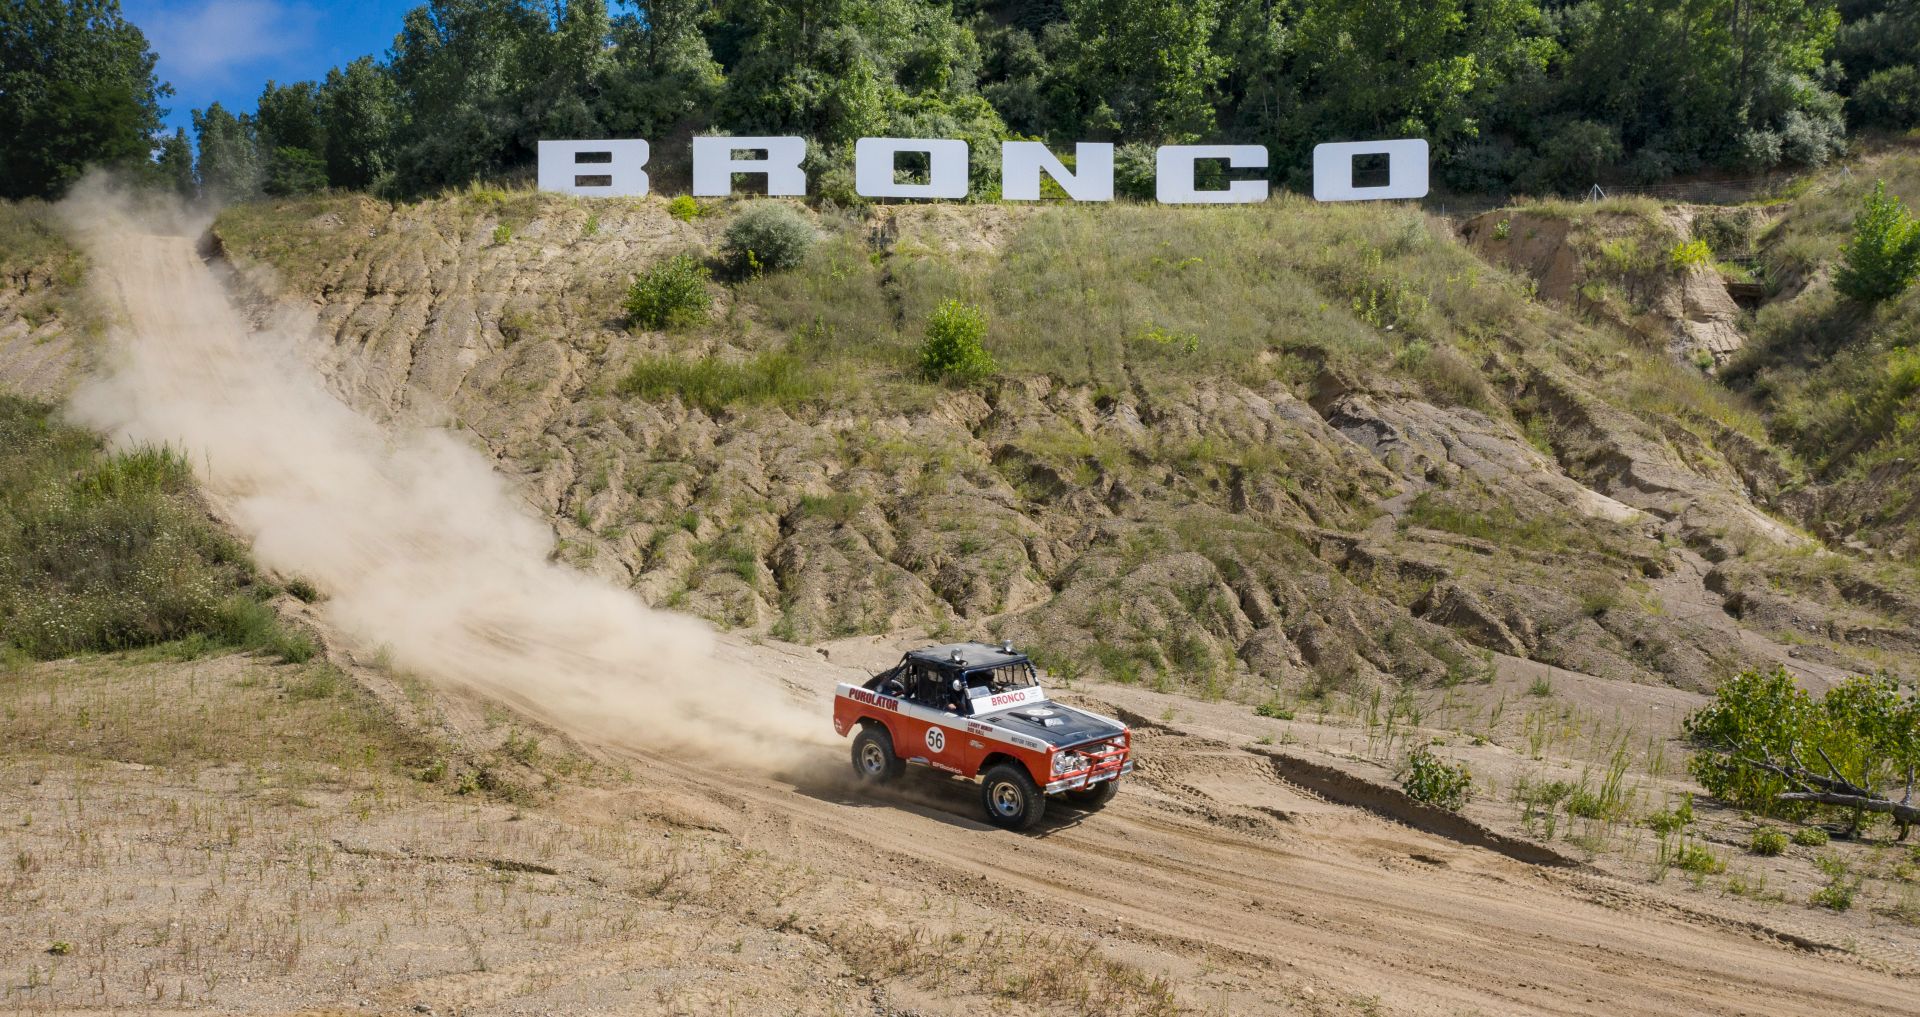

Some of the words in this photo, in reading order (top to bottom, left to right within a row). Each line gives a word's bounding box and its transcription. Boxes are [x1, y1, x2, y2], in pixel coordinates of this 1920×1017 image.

[537, 136, 1430, 204] BRONCO
[849, 688, 898, 711] PUROLATOR
[991, 692, 1025, 706] BRONCO
[928, 730, 943, 749] 56
